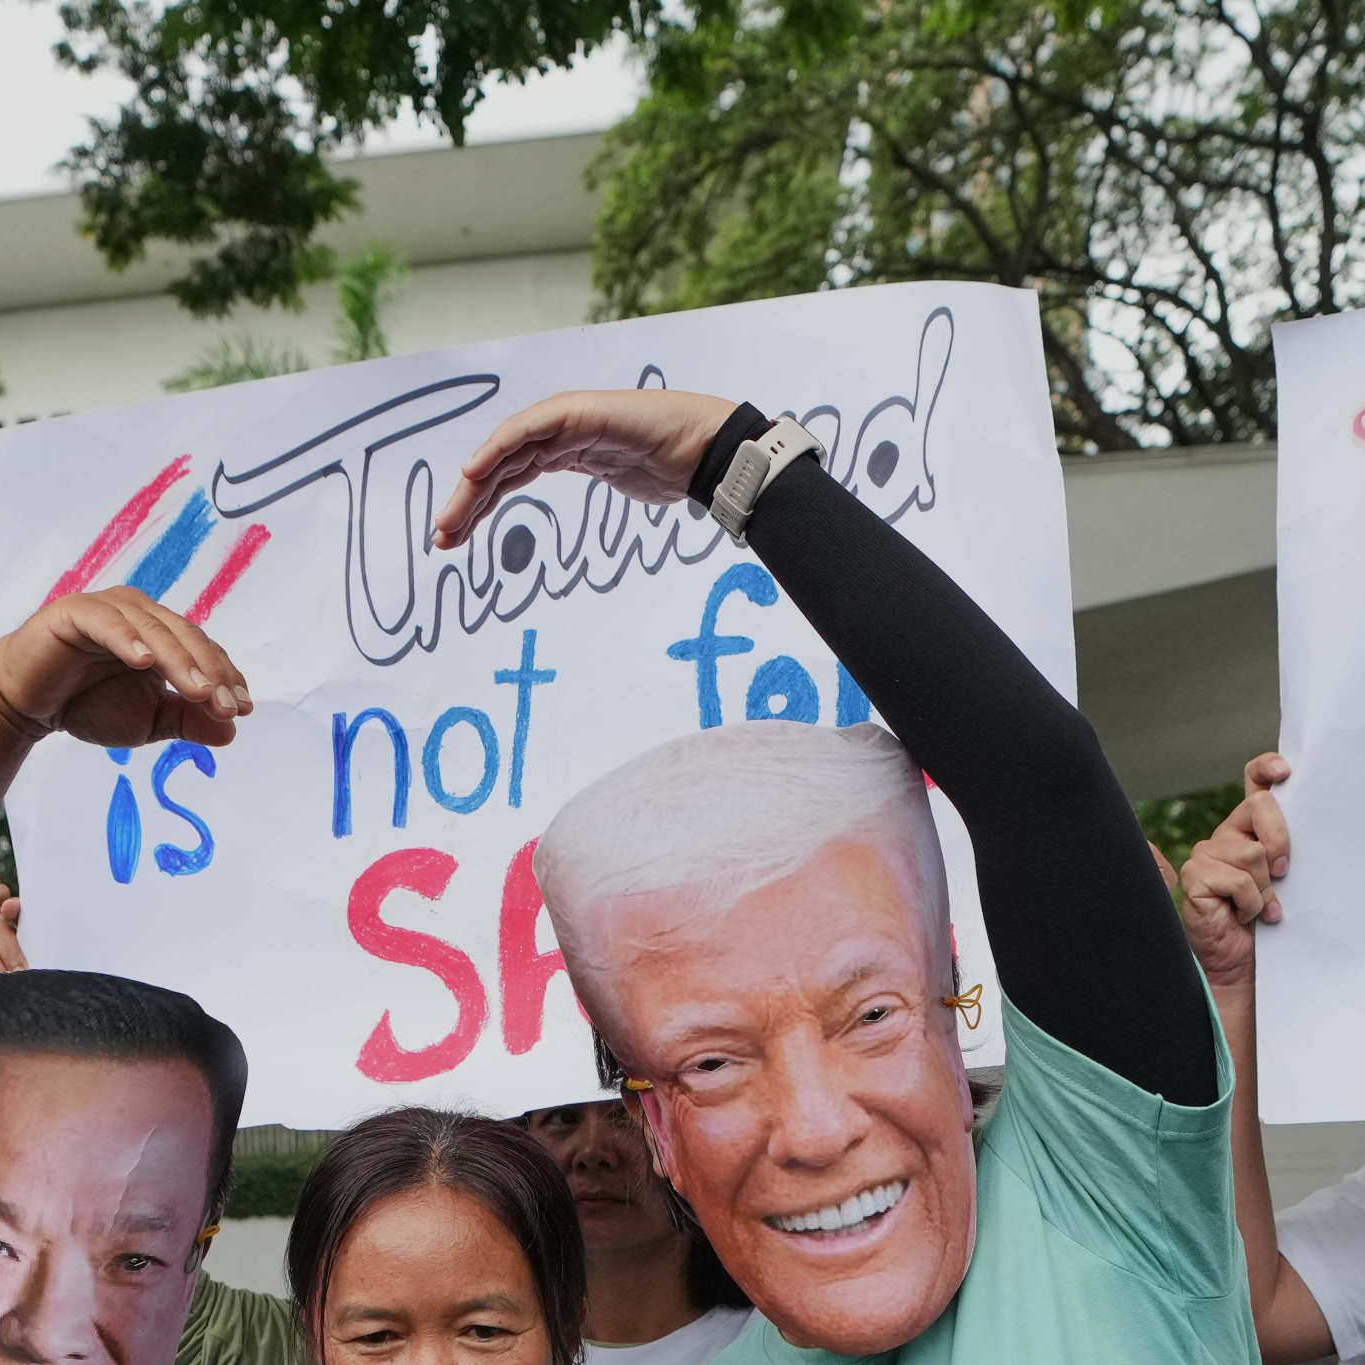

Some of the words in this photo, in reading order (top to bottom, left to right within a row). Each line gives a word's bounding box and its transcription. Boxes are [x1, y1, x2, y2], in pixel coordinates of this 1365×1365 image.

[106, 738, 217, 885] is
[332, 628, 557, 838] not
[347, 834, 592, 1084] SA
